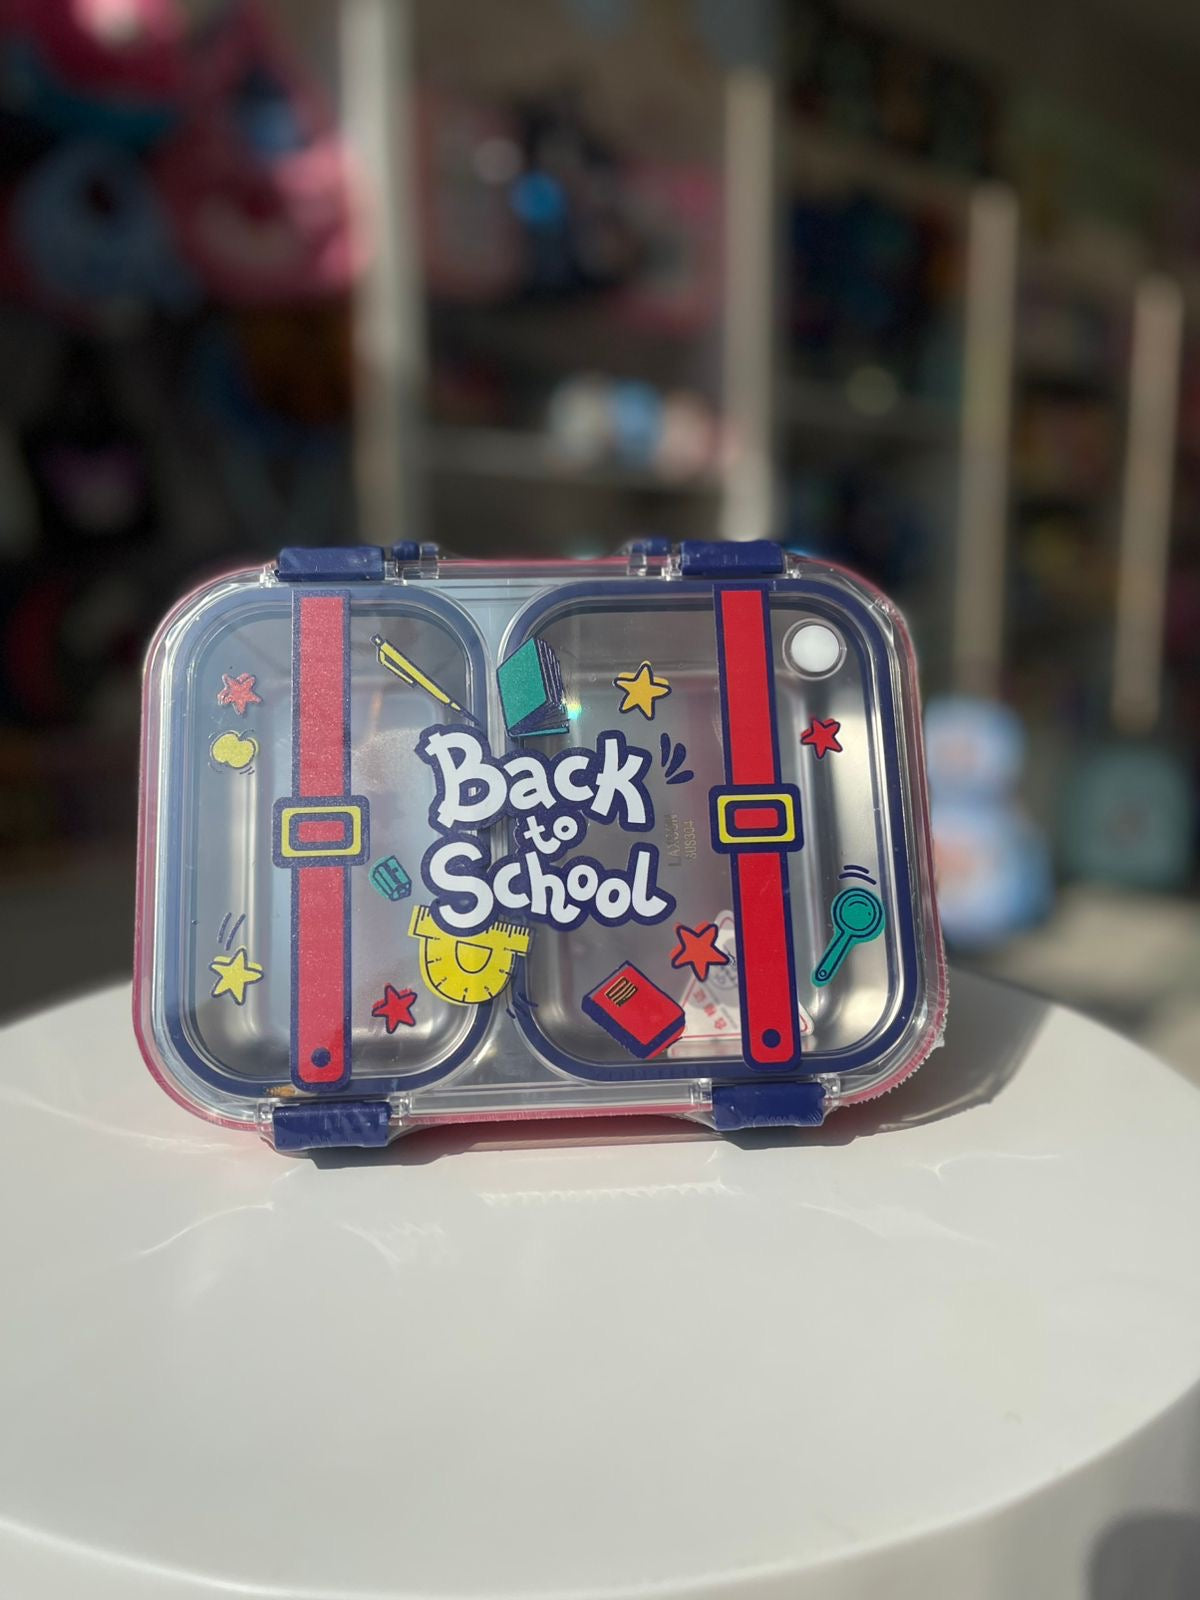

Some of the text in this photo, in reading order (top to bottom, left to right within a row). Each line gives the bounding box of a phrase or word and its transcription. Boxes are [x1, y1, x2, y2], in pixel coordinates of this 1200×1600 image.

[425, 731, 647, 828] Back
[524, 815, 578, 854] to
[429, 841, 668, 929] School
